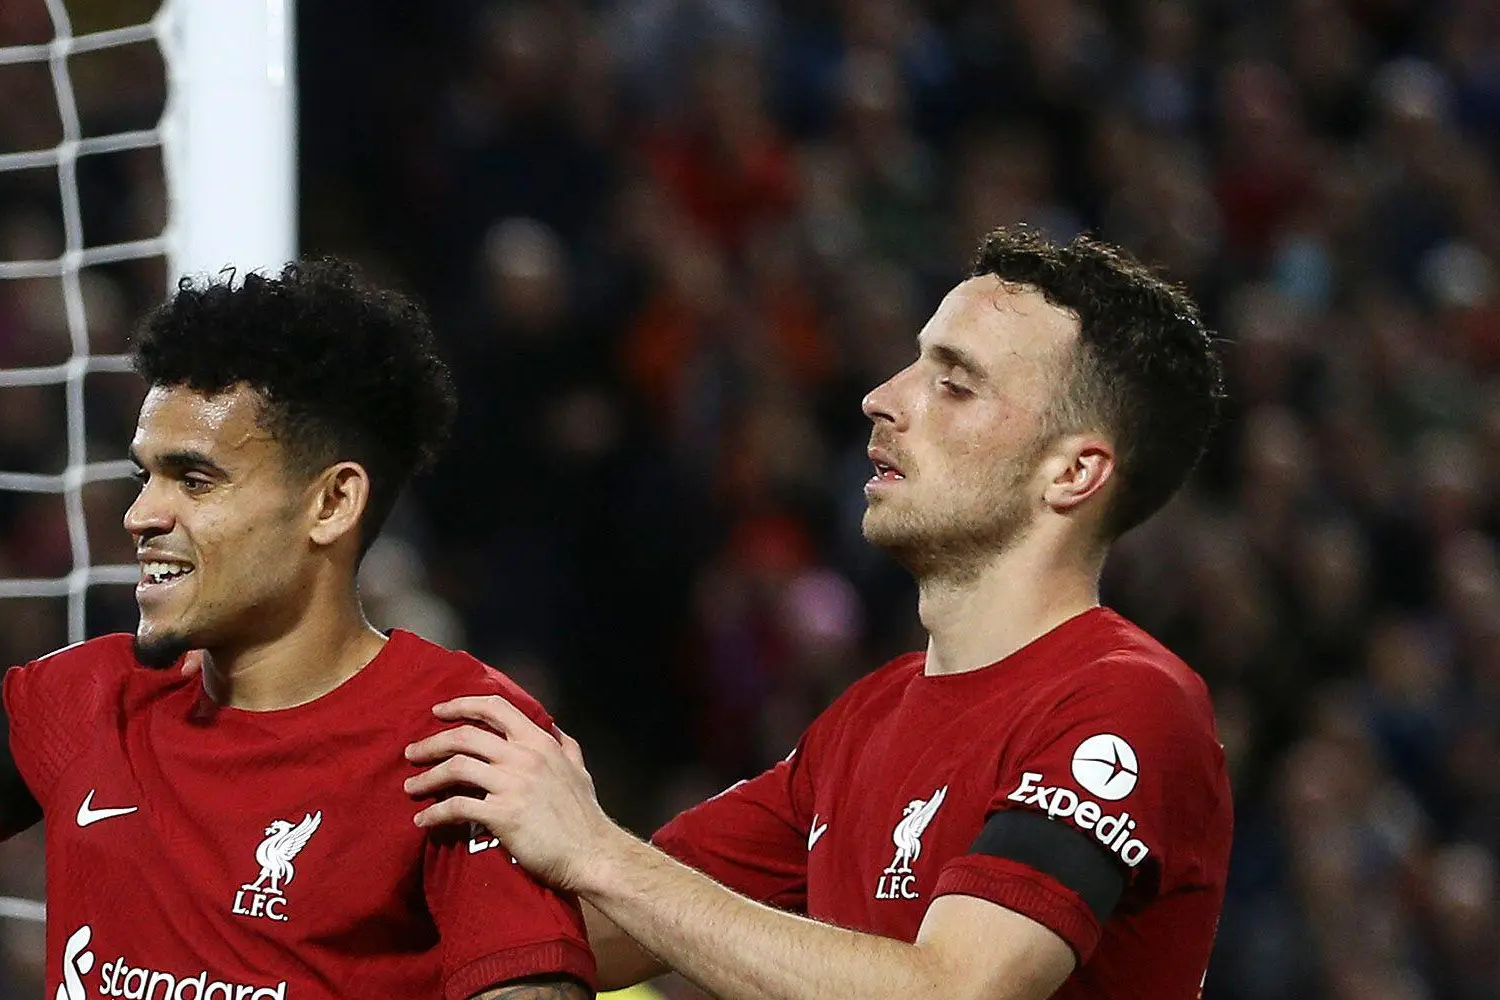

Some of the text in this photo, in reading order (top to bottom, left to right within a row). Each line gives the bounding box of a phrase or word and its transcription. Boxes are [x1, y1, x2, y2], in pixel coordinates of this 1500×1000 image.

[1007, 772, 1149, 867] Expedia
[875, 875, 919, 899] L.F.C.
[232, 890, 288, 921] L.F.C.
